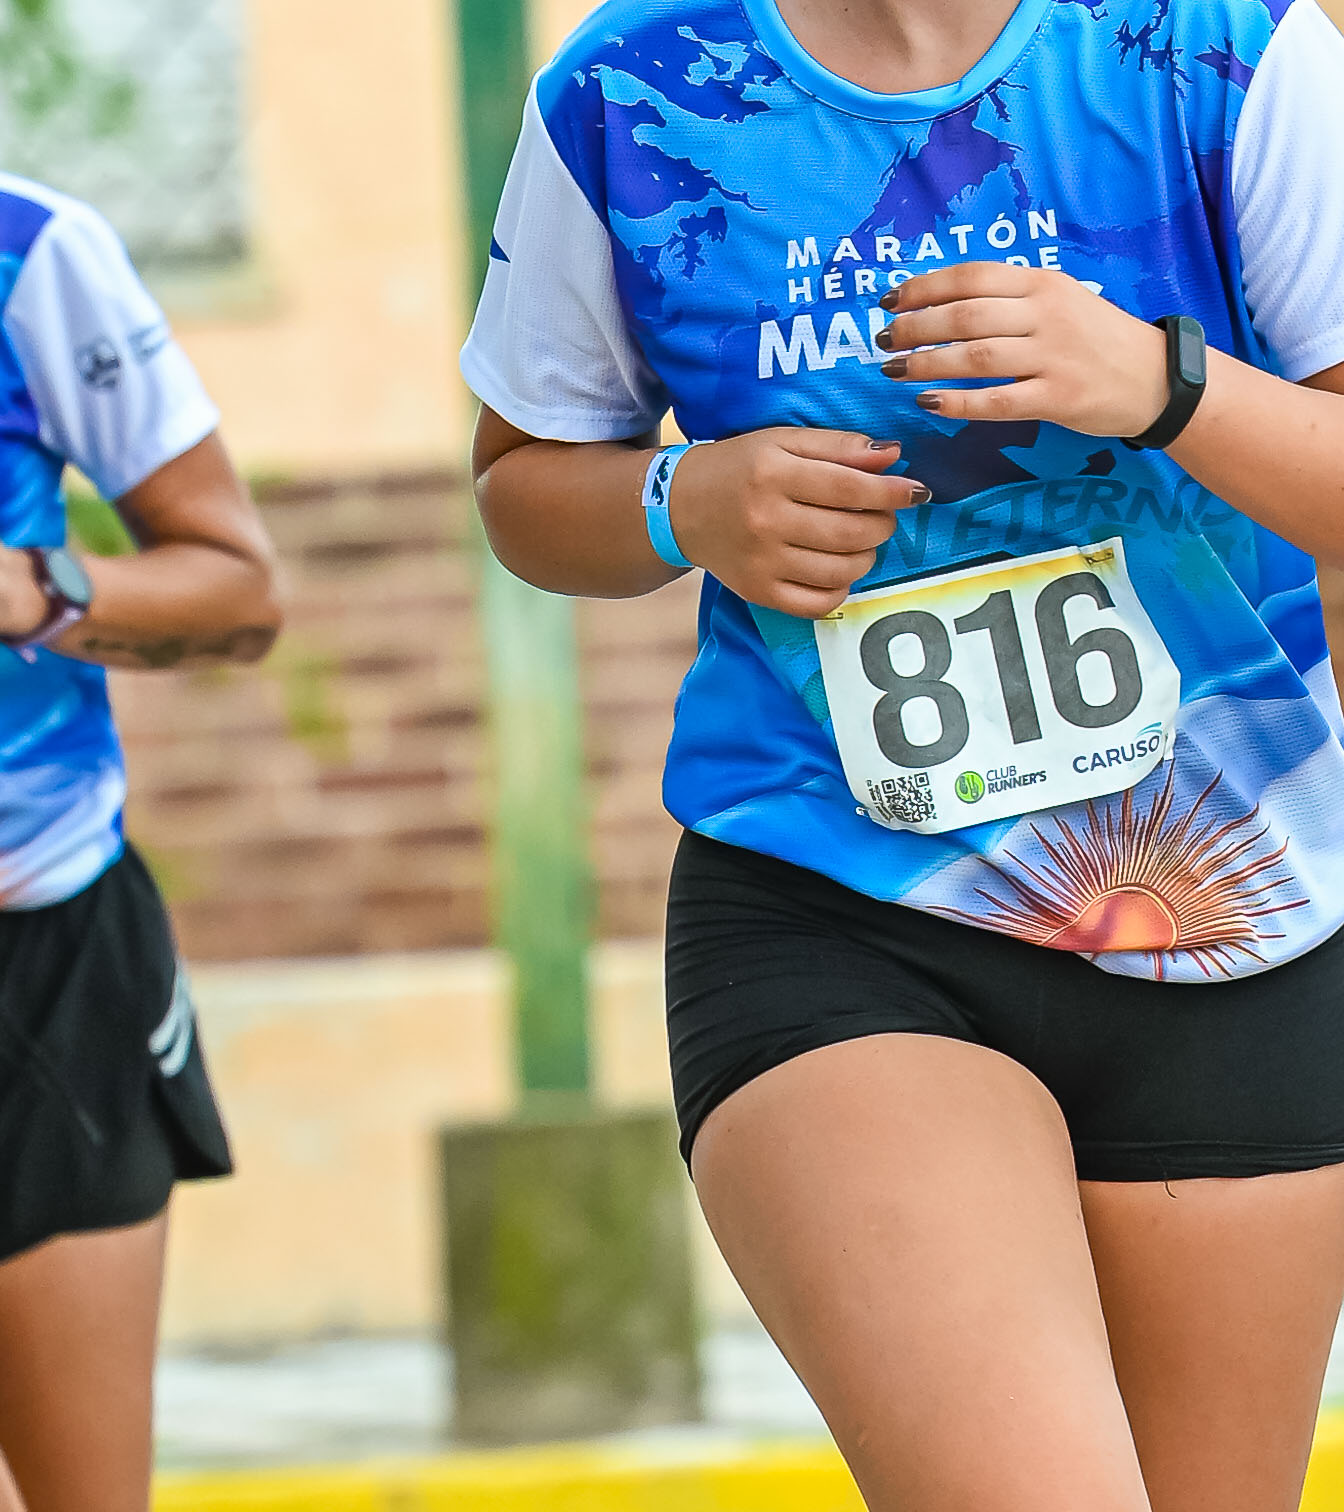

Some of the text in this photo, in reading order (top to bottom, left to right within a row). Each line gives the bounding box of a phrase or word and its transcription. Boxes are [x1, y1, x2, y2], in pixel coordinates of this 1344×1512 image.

[786, 208, 1061, 270] MARATÓN
[787, 266, 944, 304] HÉRO
[859, 571, 1144, 770] 816
[986, 765, 1018, 782] CLUB
[1072, 734, 1161, 774] CARUSO
[987, 770, 1048, 795] RUNNER'S
